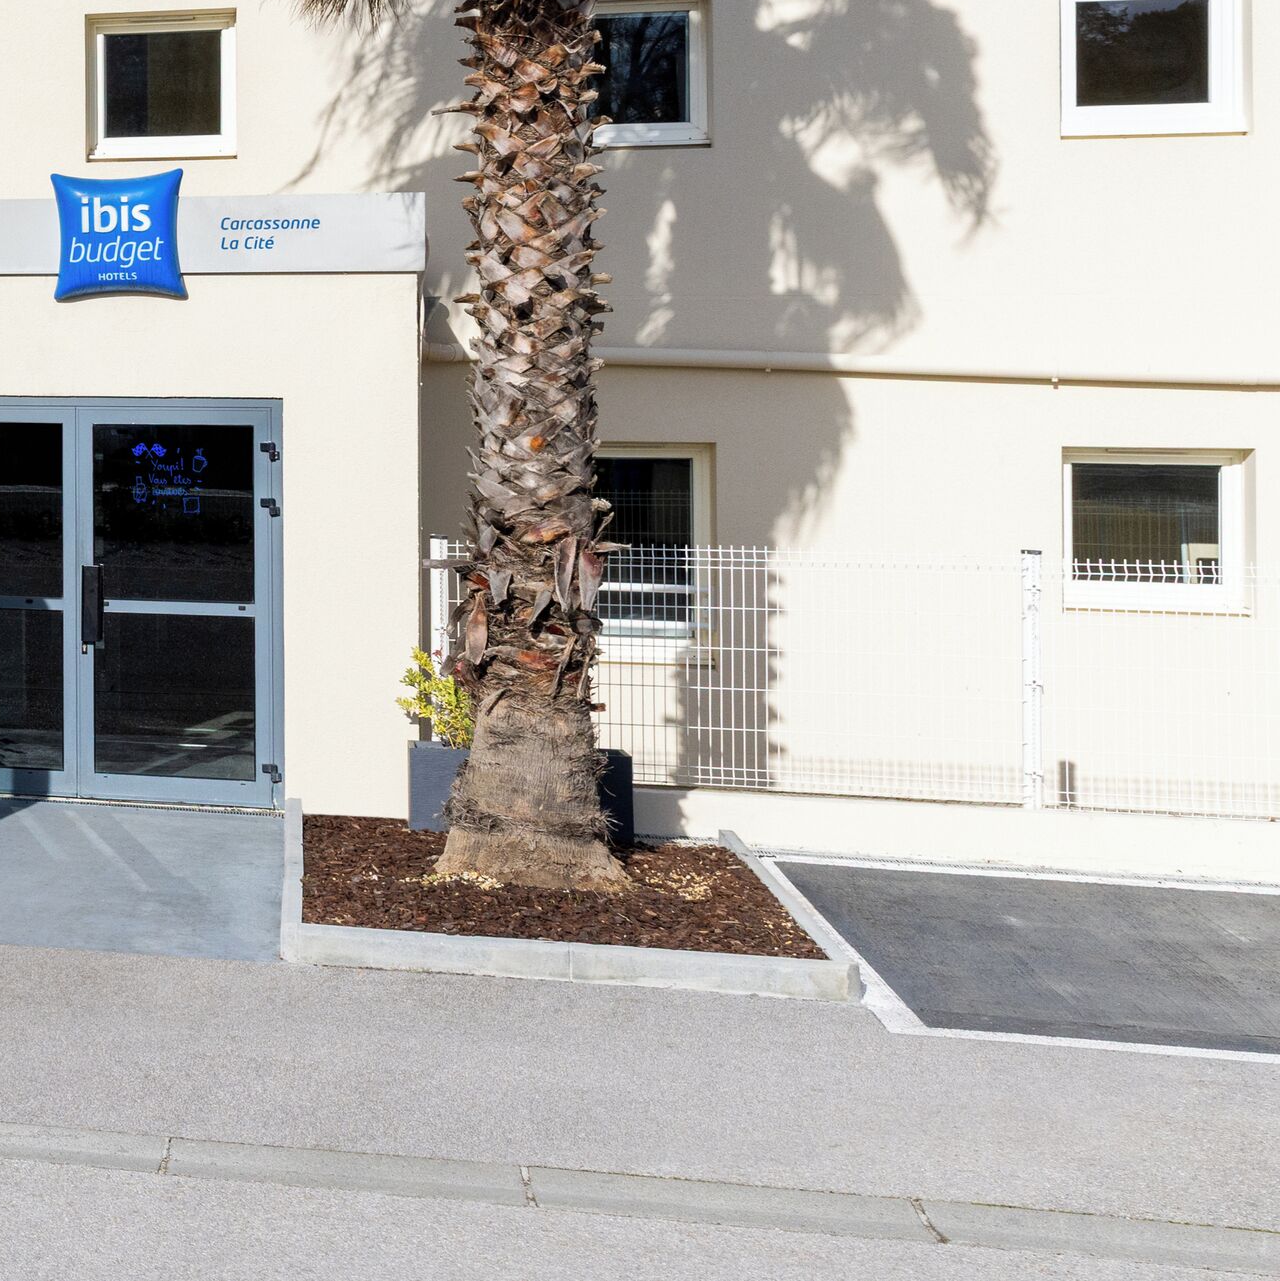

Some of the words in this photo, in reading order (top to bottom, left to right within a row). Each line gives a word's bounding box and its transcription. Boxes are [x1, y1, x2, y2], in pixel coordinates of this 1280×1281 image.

[81, 196, 151, 233] ibis
[220, 217, 321, 231] Carcassonne
[220, 236, 239, 250] La
[244, 235, 274, 250] Cité
[69, 236, 164, 268] budget
[98, 272, 137, 281] HOTELS
